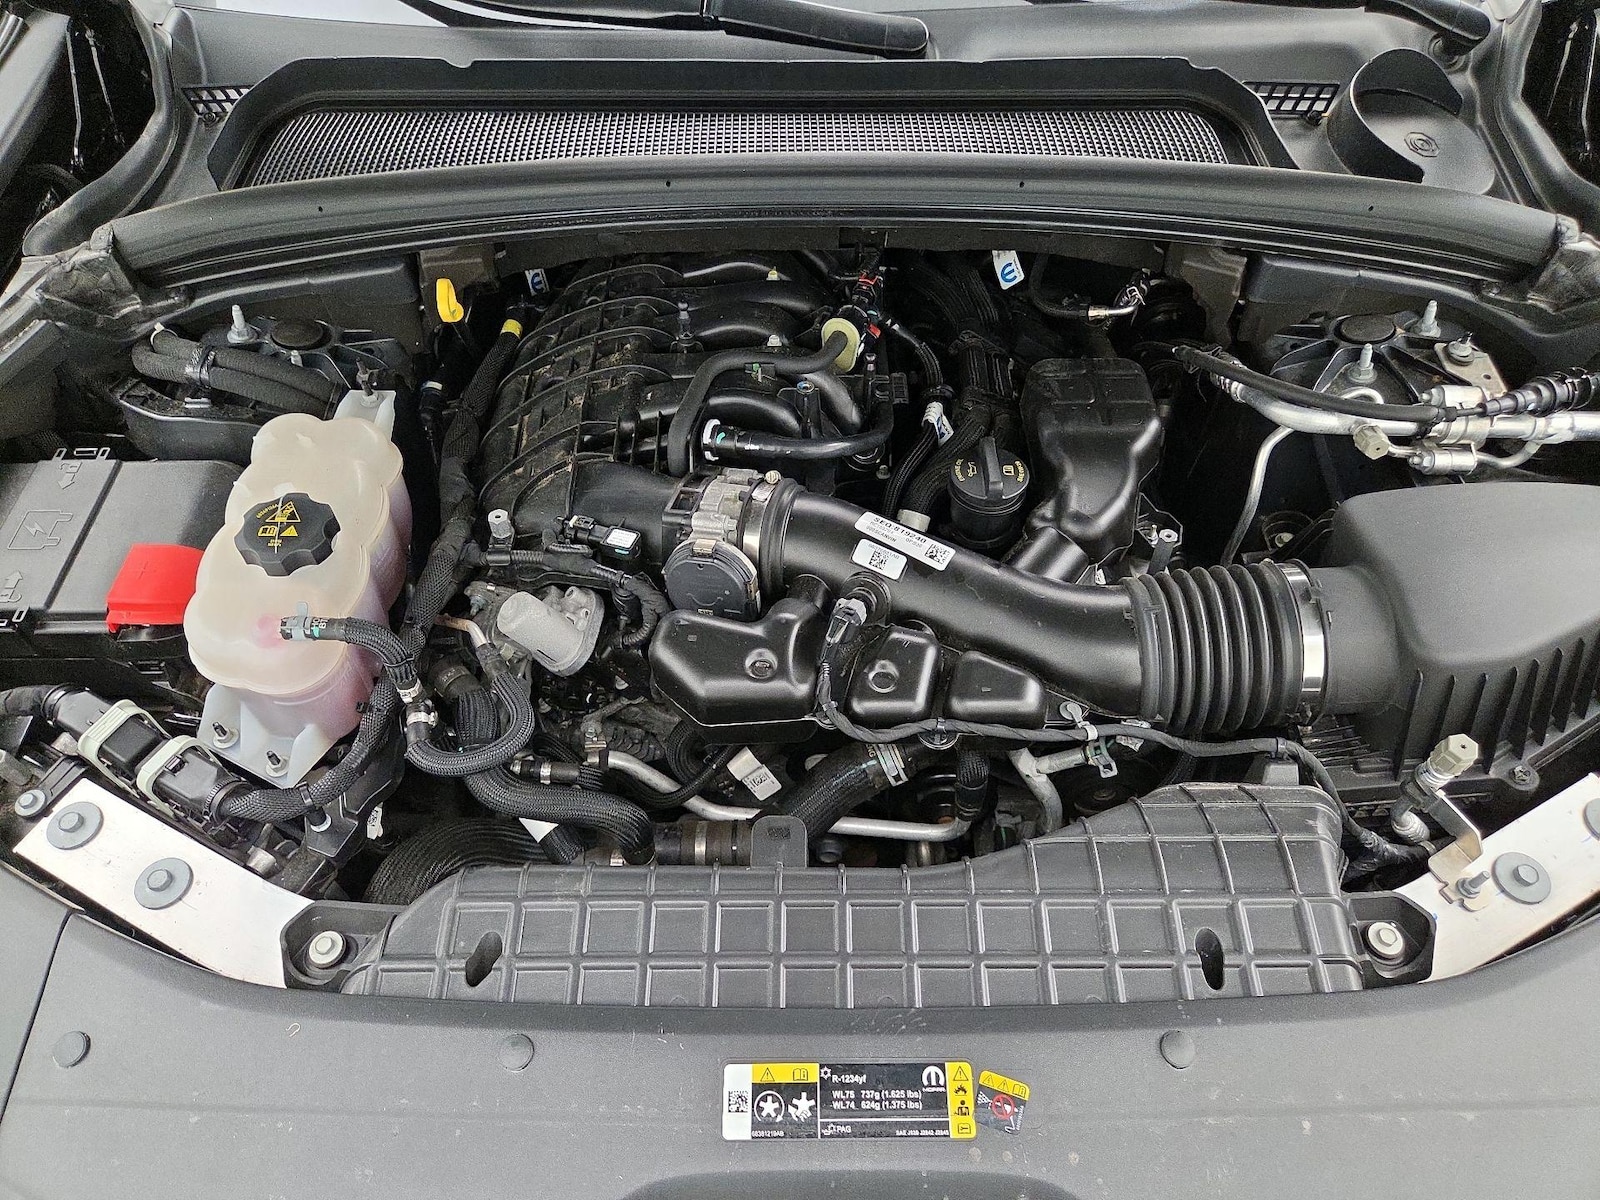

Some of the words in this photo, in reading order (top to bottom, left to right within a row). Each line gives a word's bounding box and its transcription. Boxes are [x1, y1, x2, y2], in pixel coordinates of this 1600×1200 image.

[873, 517, 927, 544] SEQ:819240
[832, 1074, 867, 1085] R-1234yf
[861, 1090, 880, 1100] 737g
[881, 1090, 906, 1100] (1.625
[907, 1089, 922, 1100] lbs)
[832, 1101, 855, 1110] WL74
[861, 1101, 880, 1111] 624g
[882, 1100, 906, 1110] (1.375
[907, 1100, 923, 1110] lbs)
[836, 1125, 852, 1133] PAG
